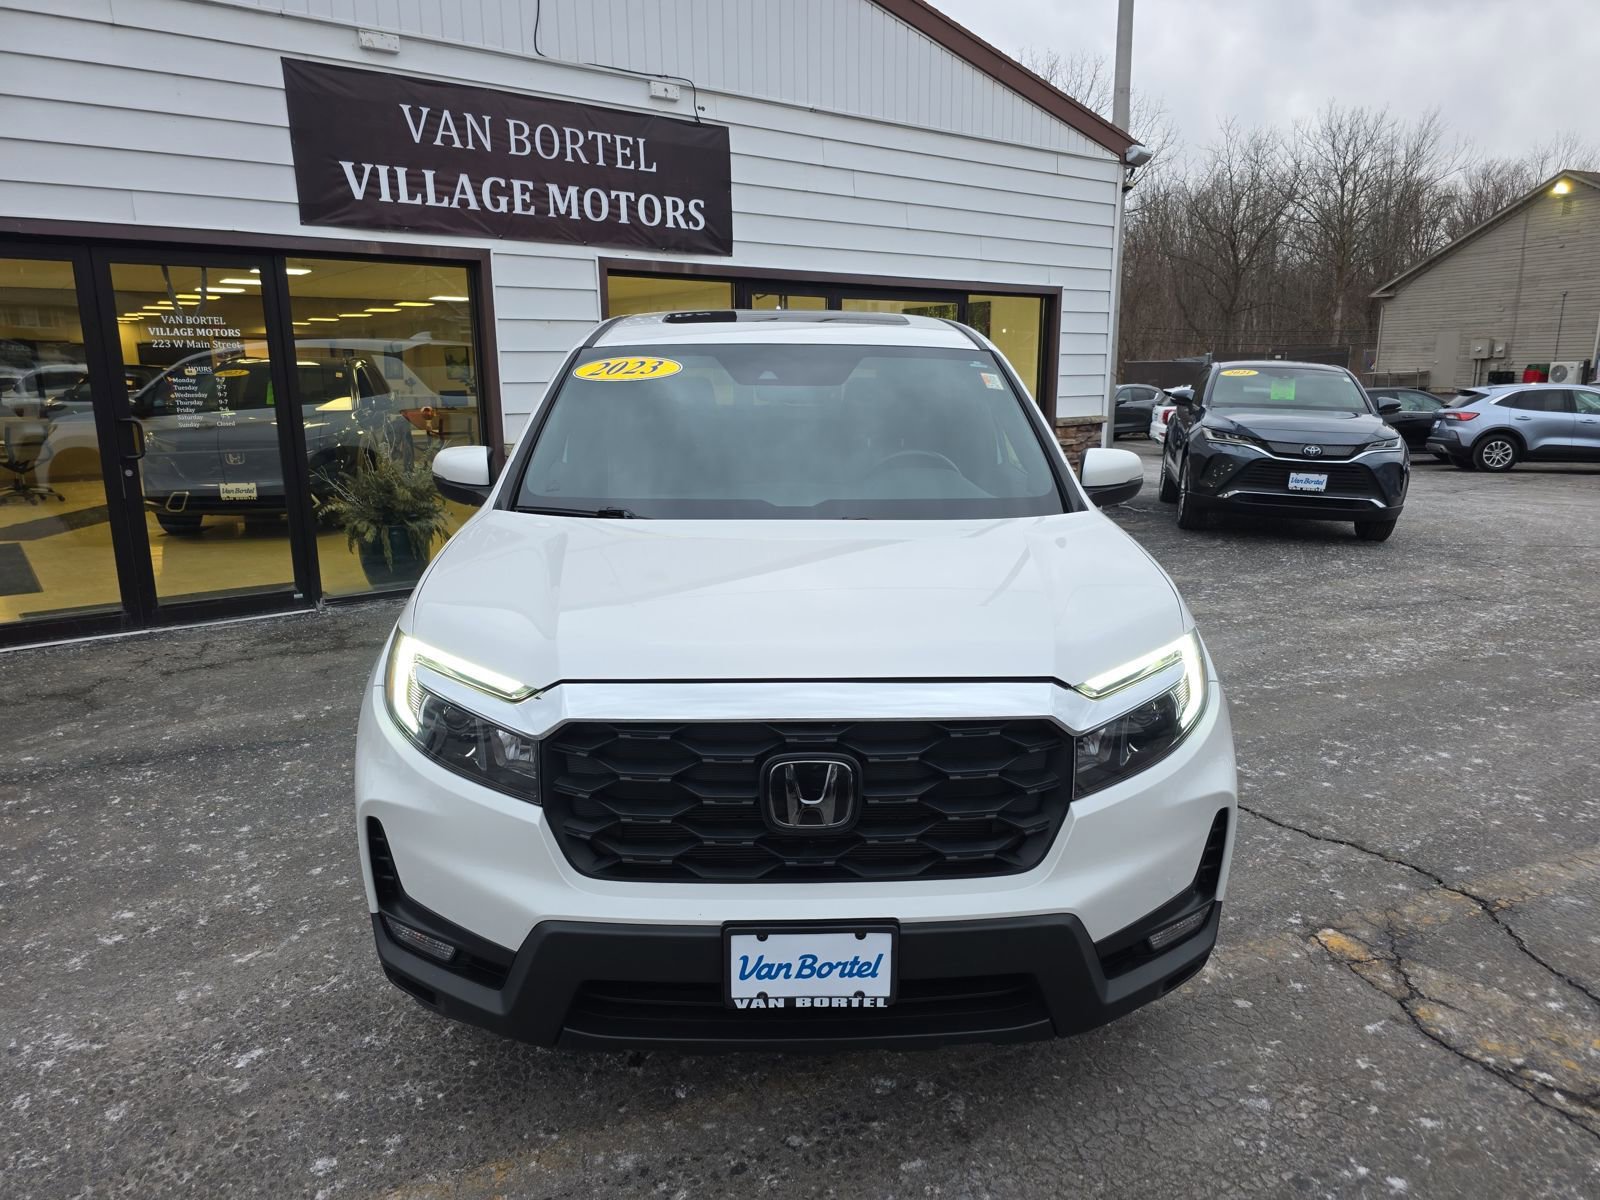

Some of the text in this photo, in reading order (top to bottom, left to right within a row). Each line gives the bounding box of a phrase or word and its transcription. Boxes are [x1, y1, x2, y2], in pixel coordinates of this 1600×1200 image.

[399, 103, 657, 173] VAN BORTEL
[339, 160, 706, 231] VILLAGE MOTORS
[161, 315, 226, 325] VAN BORTEL
[148, 327, 241, 337] VILLAGE MOTORS
[152, 339, 241, 350] 223 W Main Street
[586, 361, 663, 376] 2023
[173, 376, 197, 384] Monday
[738, 953, 884, 981] Van Bortel
[733, 996, 888, 1009] VAN BORTEL
